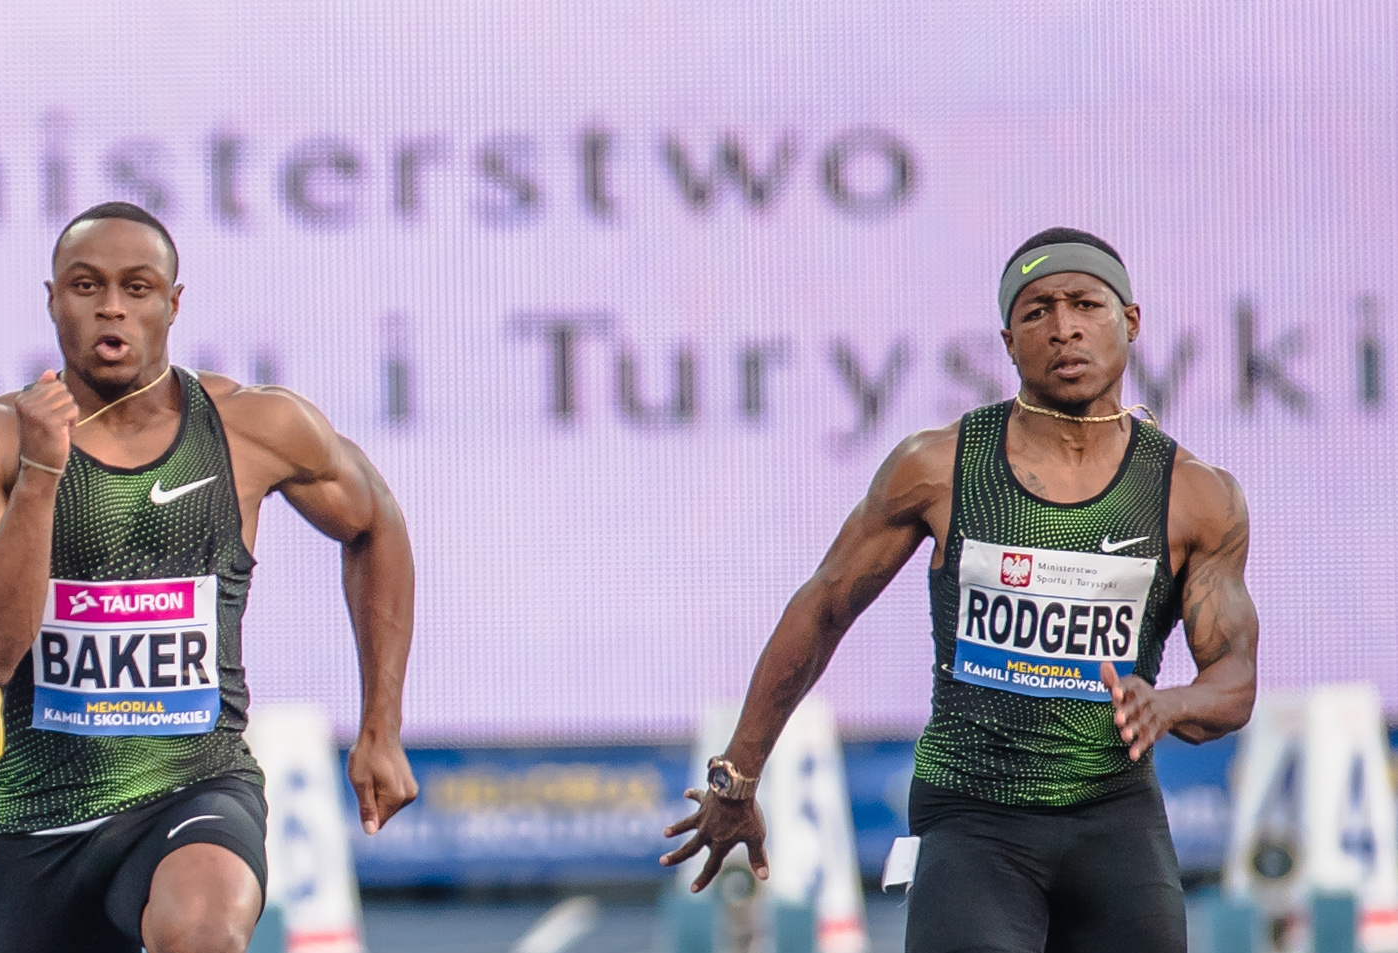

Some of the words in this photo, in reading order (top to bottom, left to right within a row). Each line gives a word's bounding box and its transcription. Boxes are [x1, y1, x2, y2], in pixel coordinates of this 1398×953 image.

[516, 291, 1387, 450] Turysyki
[1038, 562, 1097, 575] Ministerstwo
[1036, 575, 1067, 585] Sportu
[1077, 578, 1117, 589] Turystyki
[99, 591, 184, 613] TAURON
[965, 588, 1133, 657] RODGERS
[40, 630, 210, 689] BAKER
[1006, 659, 1082, 679] MEMORIAŁ
[963, 661, 1009, 682] KAMILI
[1012, 672, 1109, 694] SKOLIMOWSK
[43, 707, 89, 726] KAMILI
[93, 709, 211, 726] SKOLIMOWSKIEJ
[86, 701, 165, 713] MEMORIAŁ
